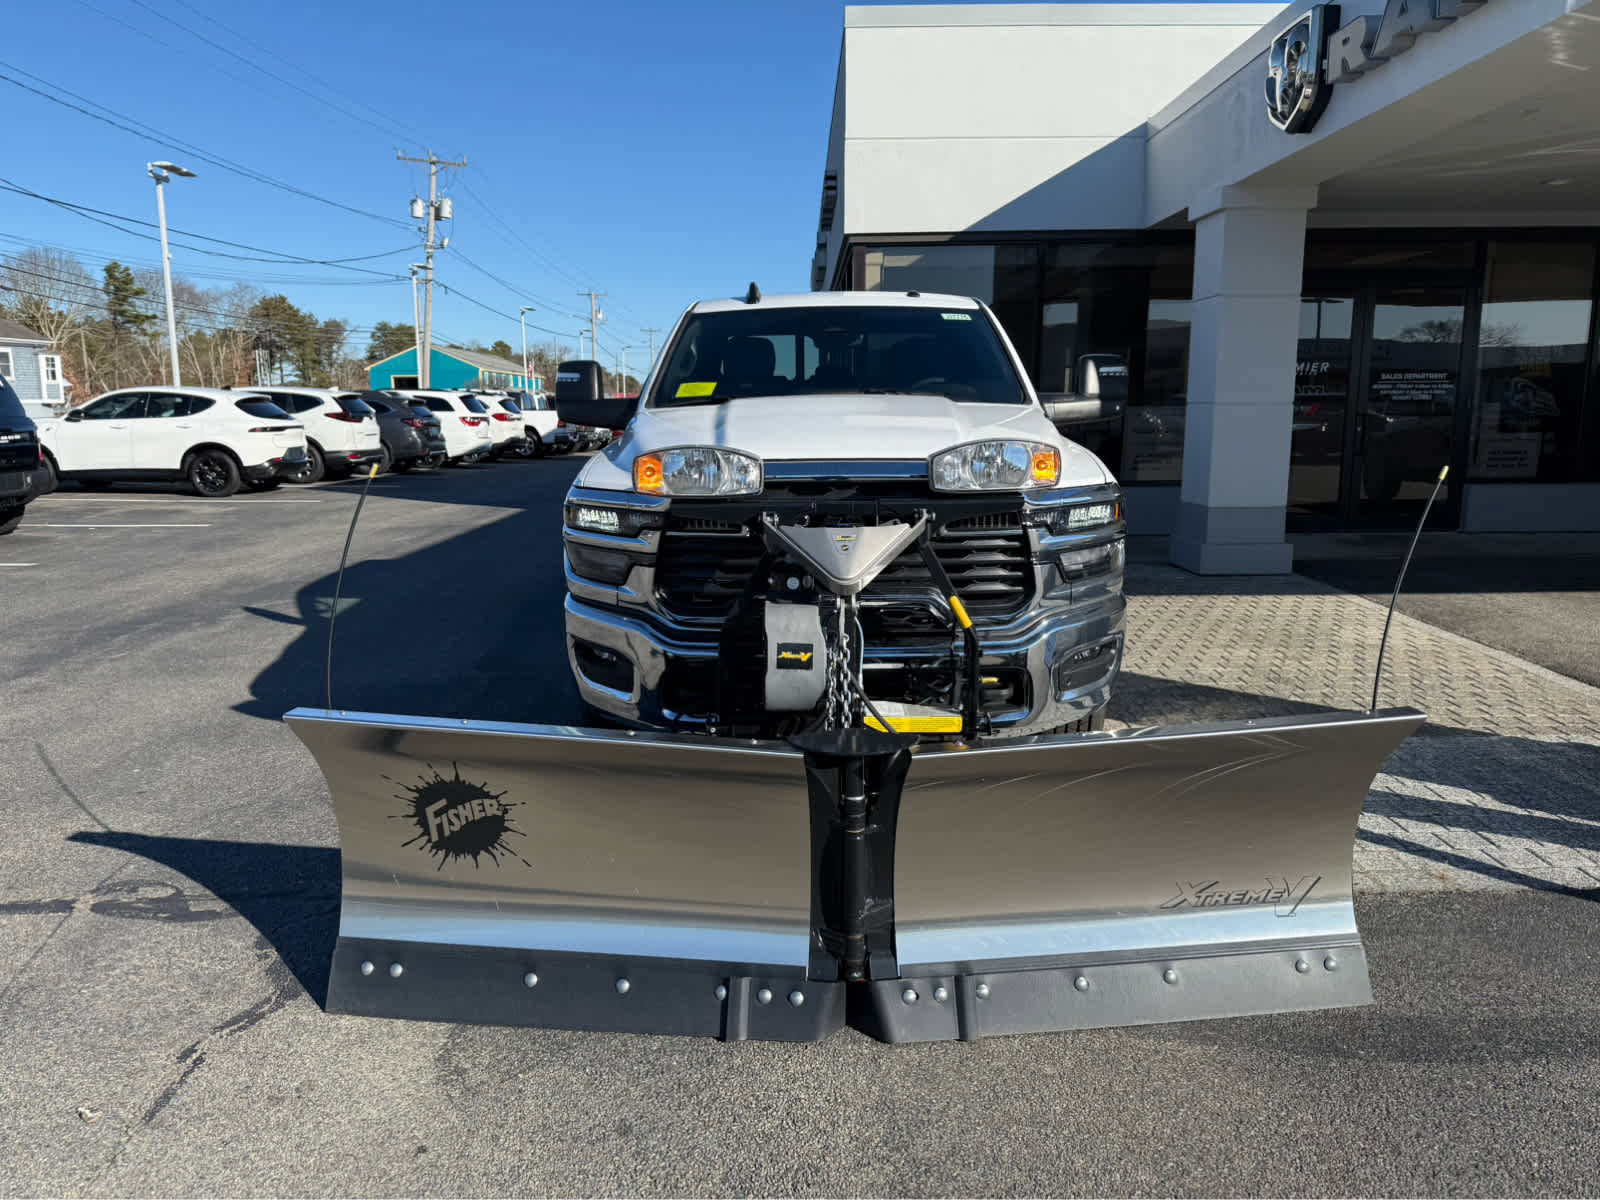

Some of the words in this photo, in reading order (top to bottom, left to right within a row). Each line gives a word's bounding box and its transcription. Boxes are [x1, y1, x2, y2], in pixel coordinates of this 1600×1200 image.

[1327, 0, 1478, 84] RA
[1381, 372, 1402, 380] SALES
[425, 798, 502, 842] FISHER
